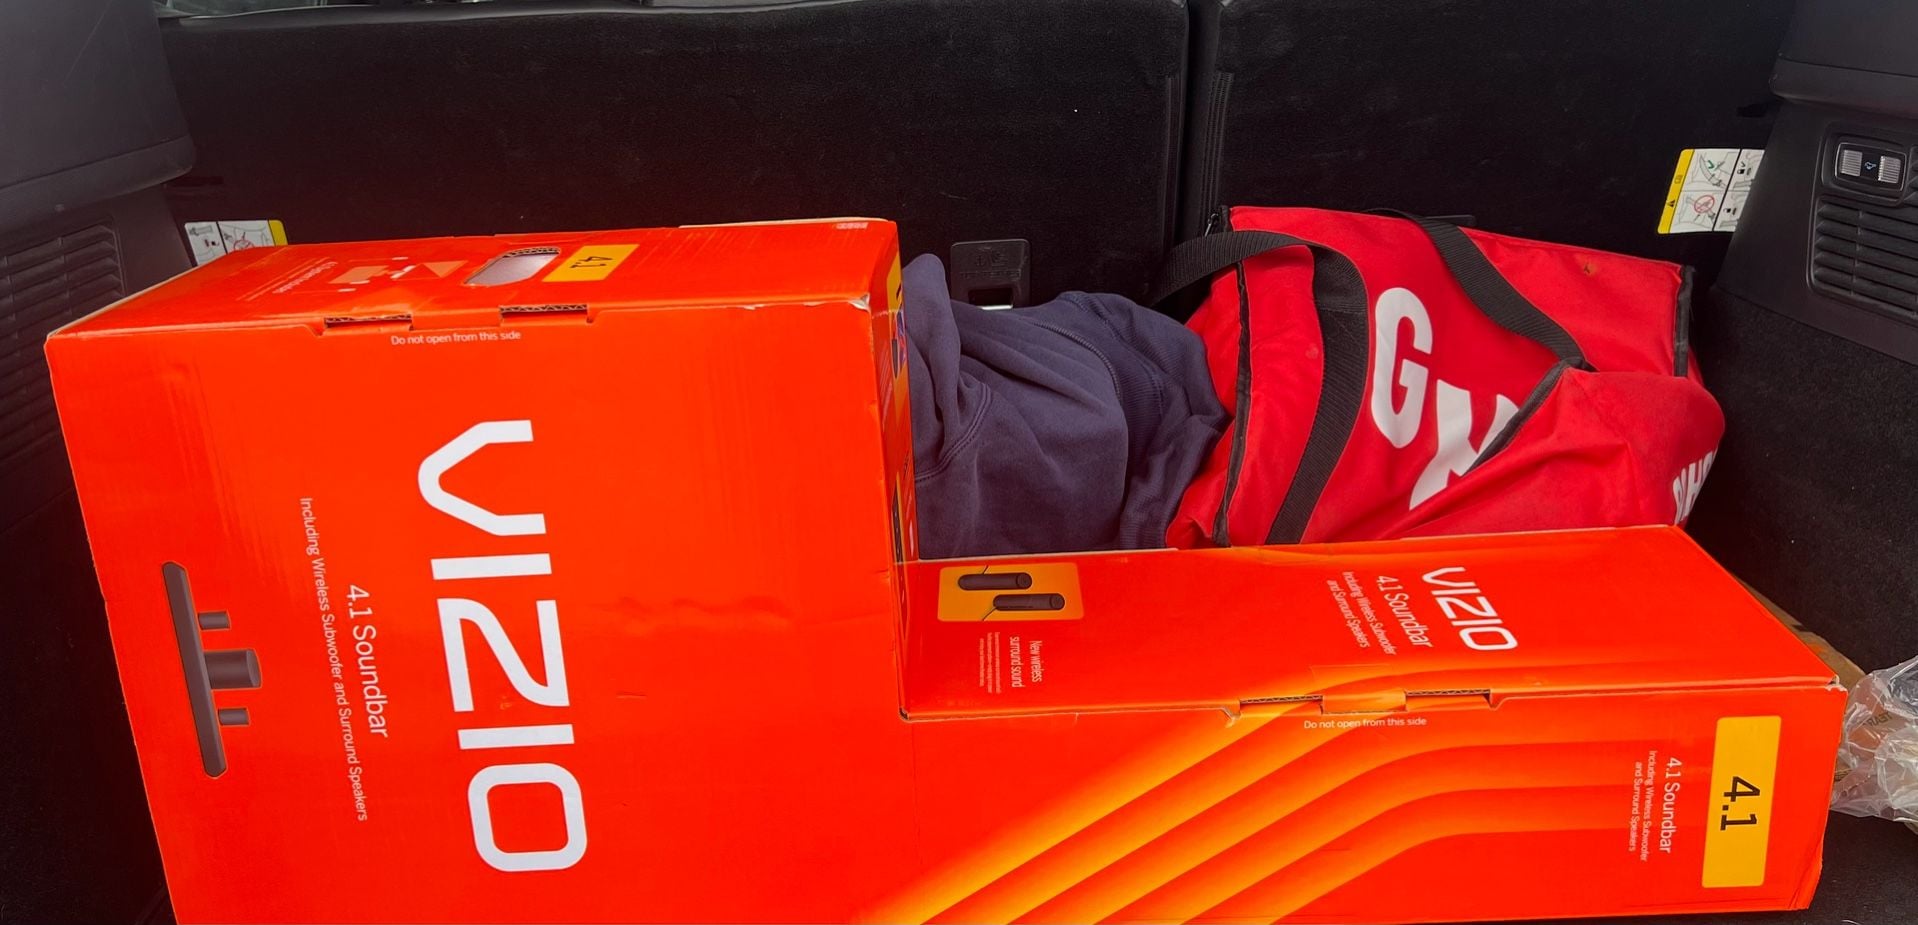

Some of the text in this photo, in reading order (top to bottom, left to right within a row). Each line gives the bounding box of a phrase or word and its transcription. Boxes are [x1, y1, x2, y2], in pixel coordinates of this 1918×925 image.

[391, 331, 521, 345] Do not open from this side
[418, 419, 588, 872] VIZIO
[1326, 579, 1371, 648] and Surround Speakers
[1342, 571, 1397, 655] Including Wireless Subwoofer
[1376, 575, 1434, 647] 4.1 Soundbar
[1421, 566, 1519, 650] VIZIO
[300, 497, 368, 822] Including Wireless Subwoofer and Surround Speakers
[347, 584, 389, 738] 4.1 Soundbar
[1009, 636, 1026, 688] surround sound
[1029, 640, 1045, 683] New wireless
[1303, 717, 1427, 729] Do not open from this side
[1628, 761, 1643, 852] and Surround Speakers
[1640, 750, 1658, 862] Including Wireless Subwoofer
[1659, 757, 1682, 853] 4.1 Soundbar
[1720, 776, 1760, 831] 4.1
